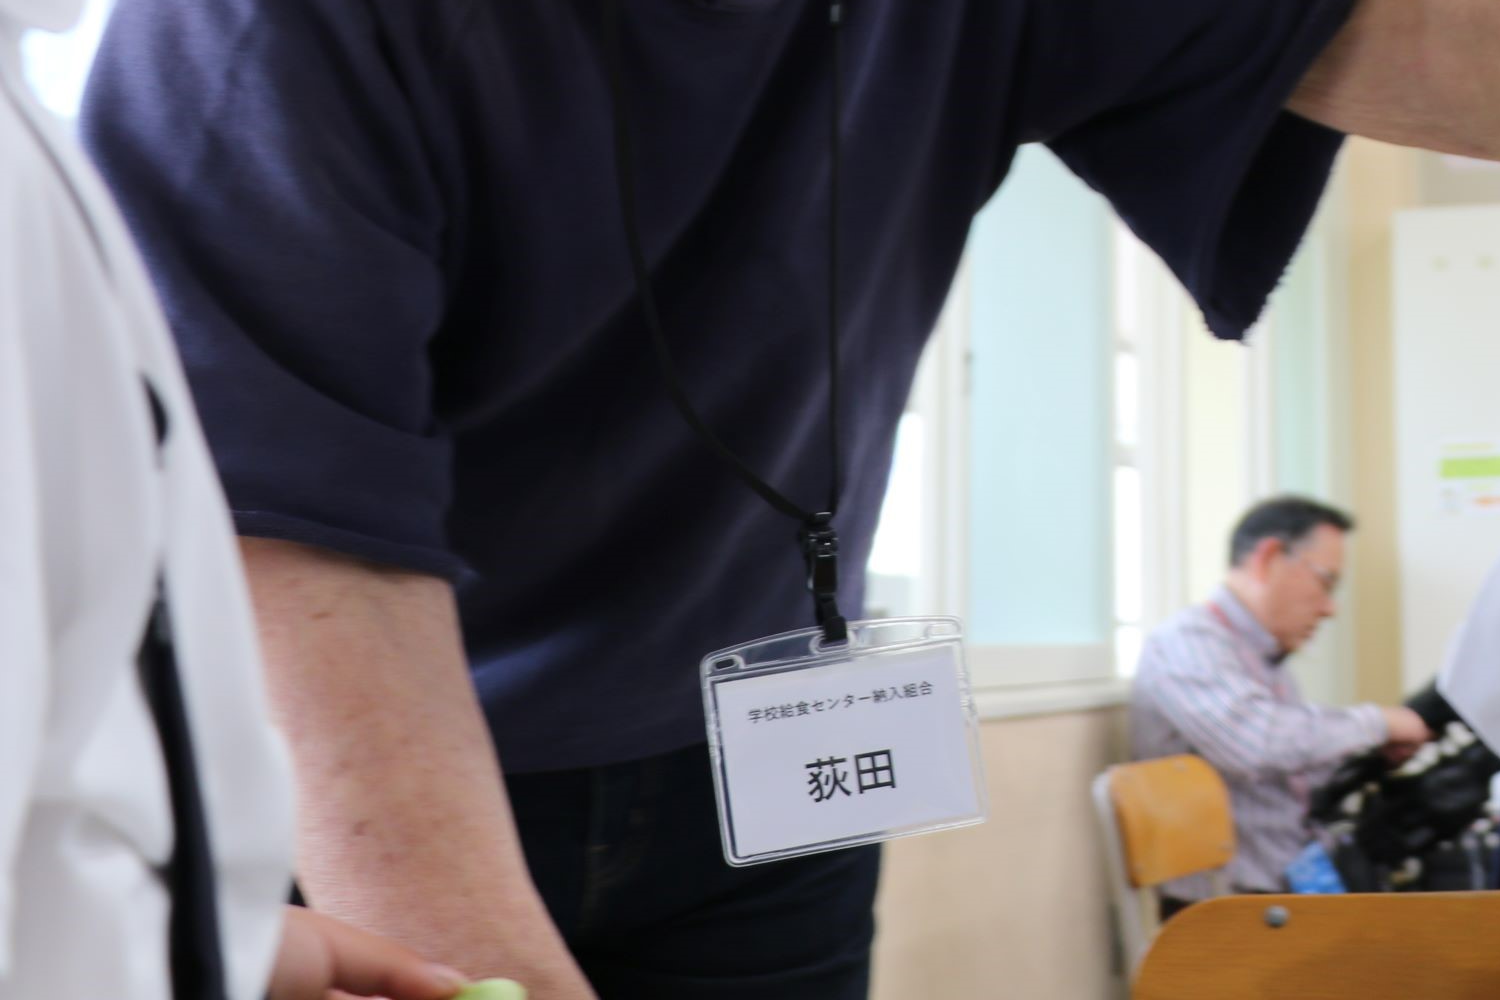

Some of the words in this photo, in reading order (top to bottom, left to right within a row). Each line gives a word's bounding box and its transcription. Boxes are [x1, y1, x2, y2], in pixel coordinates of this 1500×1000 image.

[748, 682, 933, 723] 学校給食センター納入組合
[804, 749, 896, 802] 荻田
